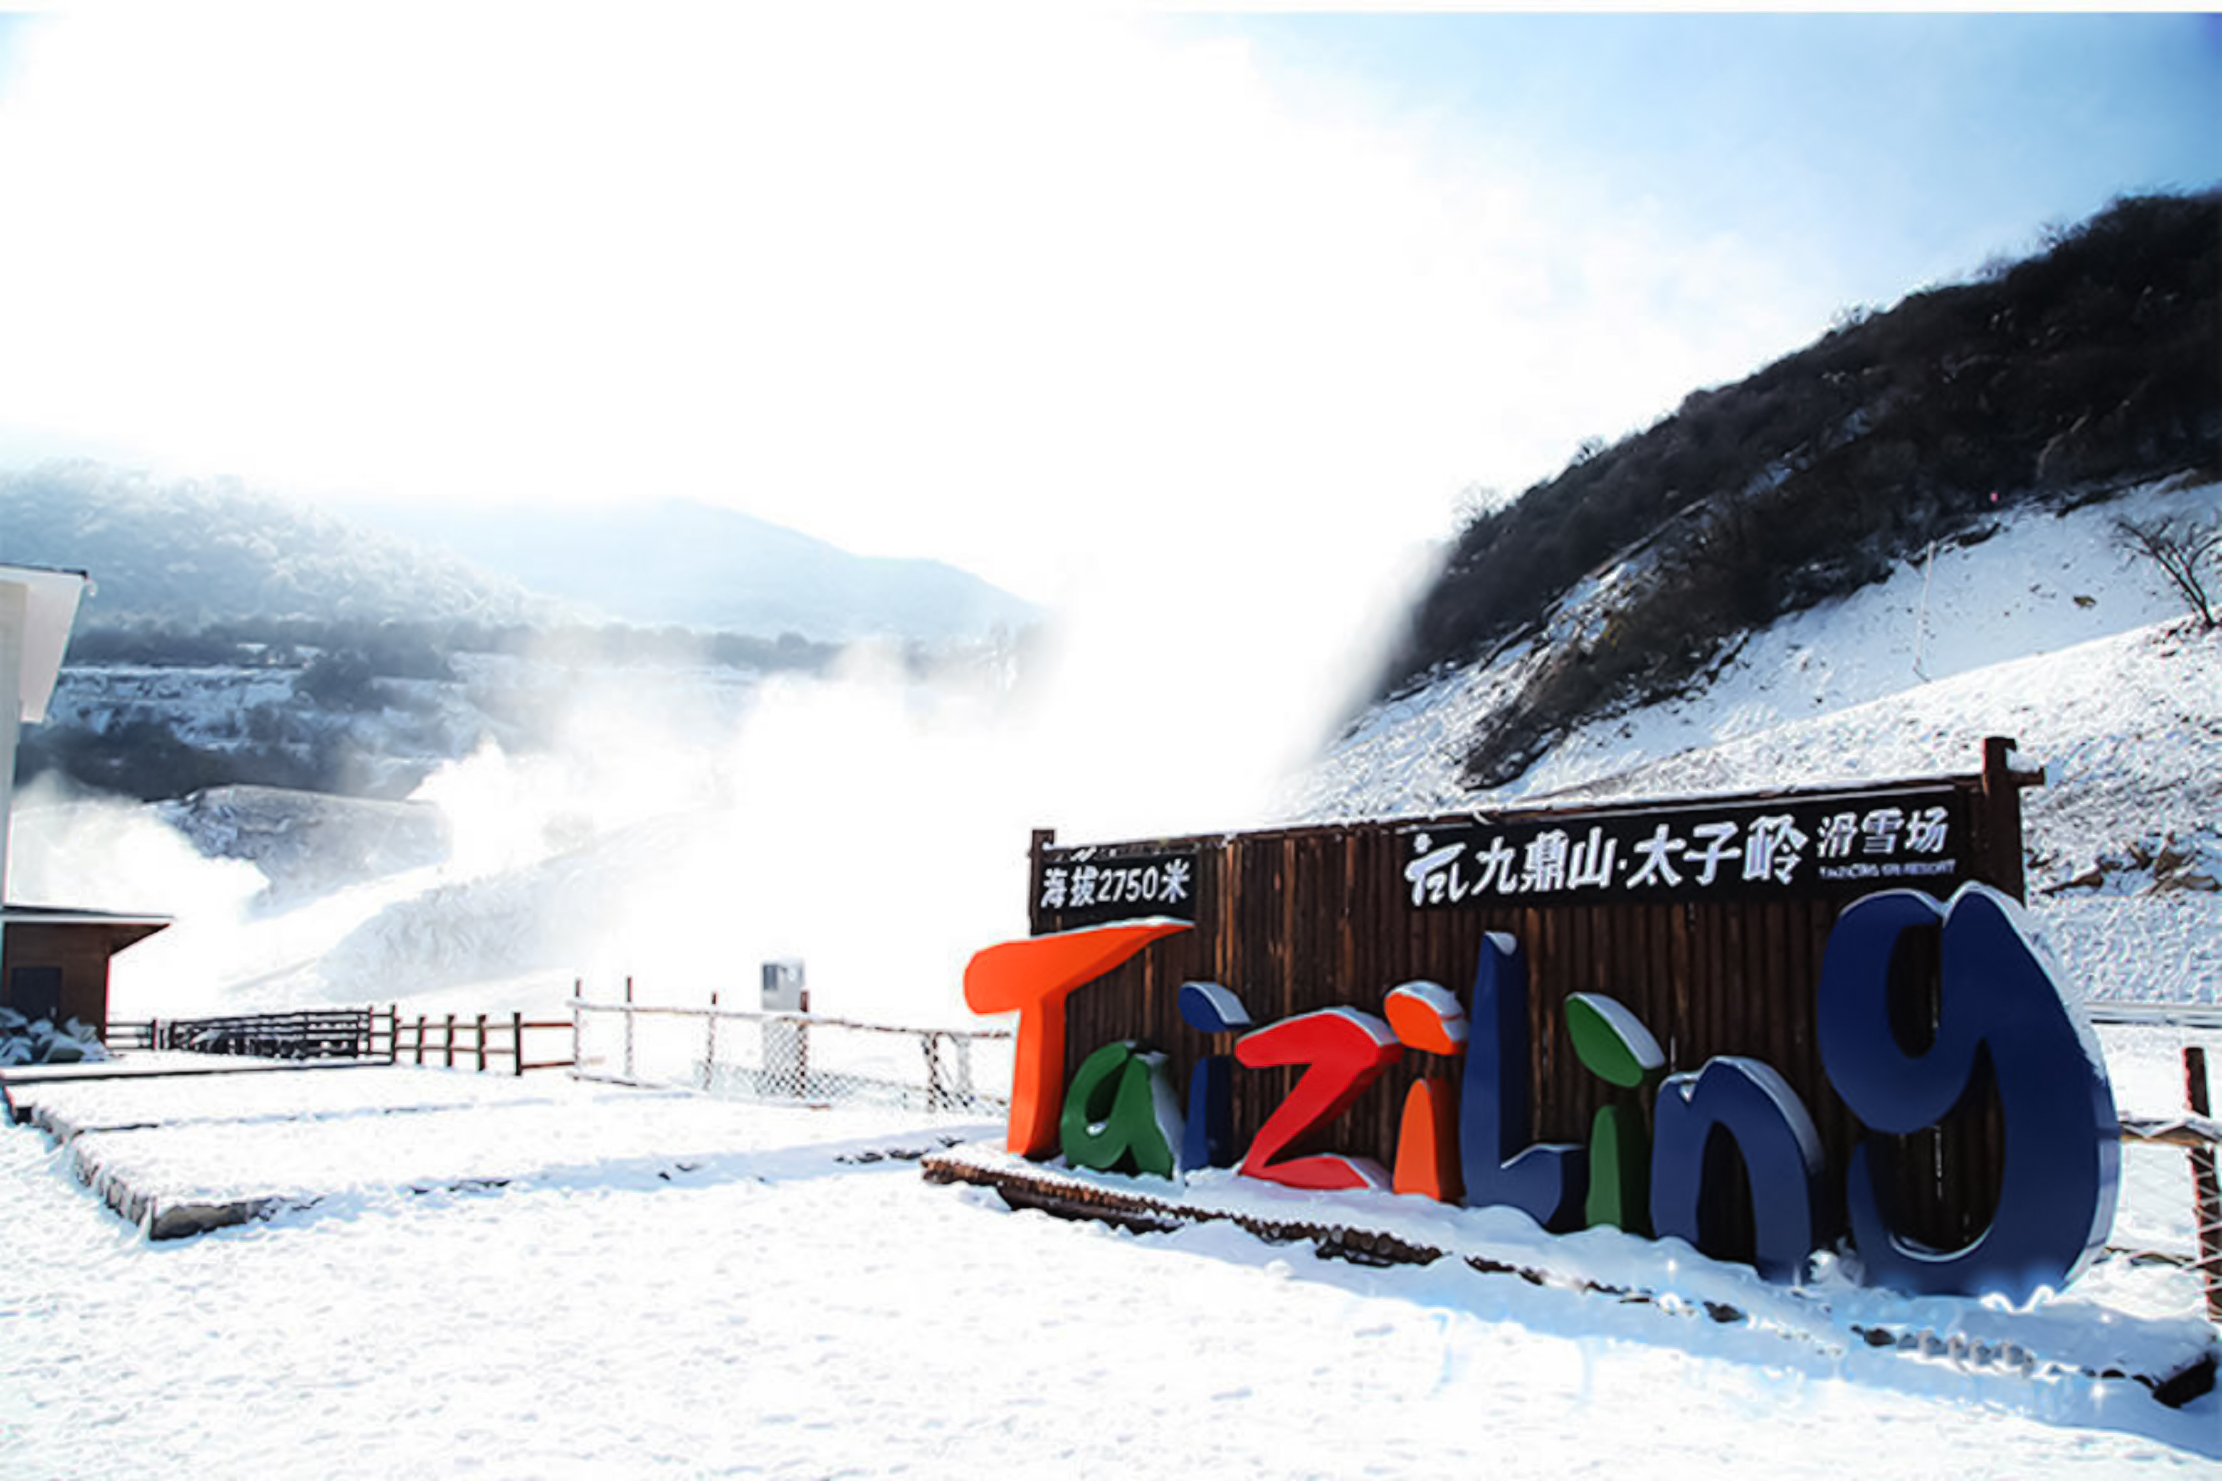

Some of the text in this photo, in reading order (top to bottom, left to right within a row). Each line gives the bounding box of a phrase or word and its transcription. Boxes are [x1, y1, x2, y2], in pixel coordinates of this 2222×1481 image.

[1817, 807, 1948, 858] 滑雪场
[1040, 858, 1190, 908] 海拔2750米
